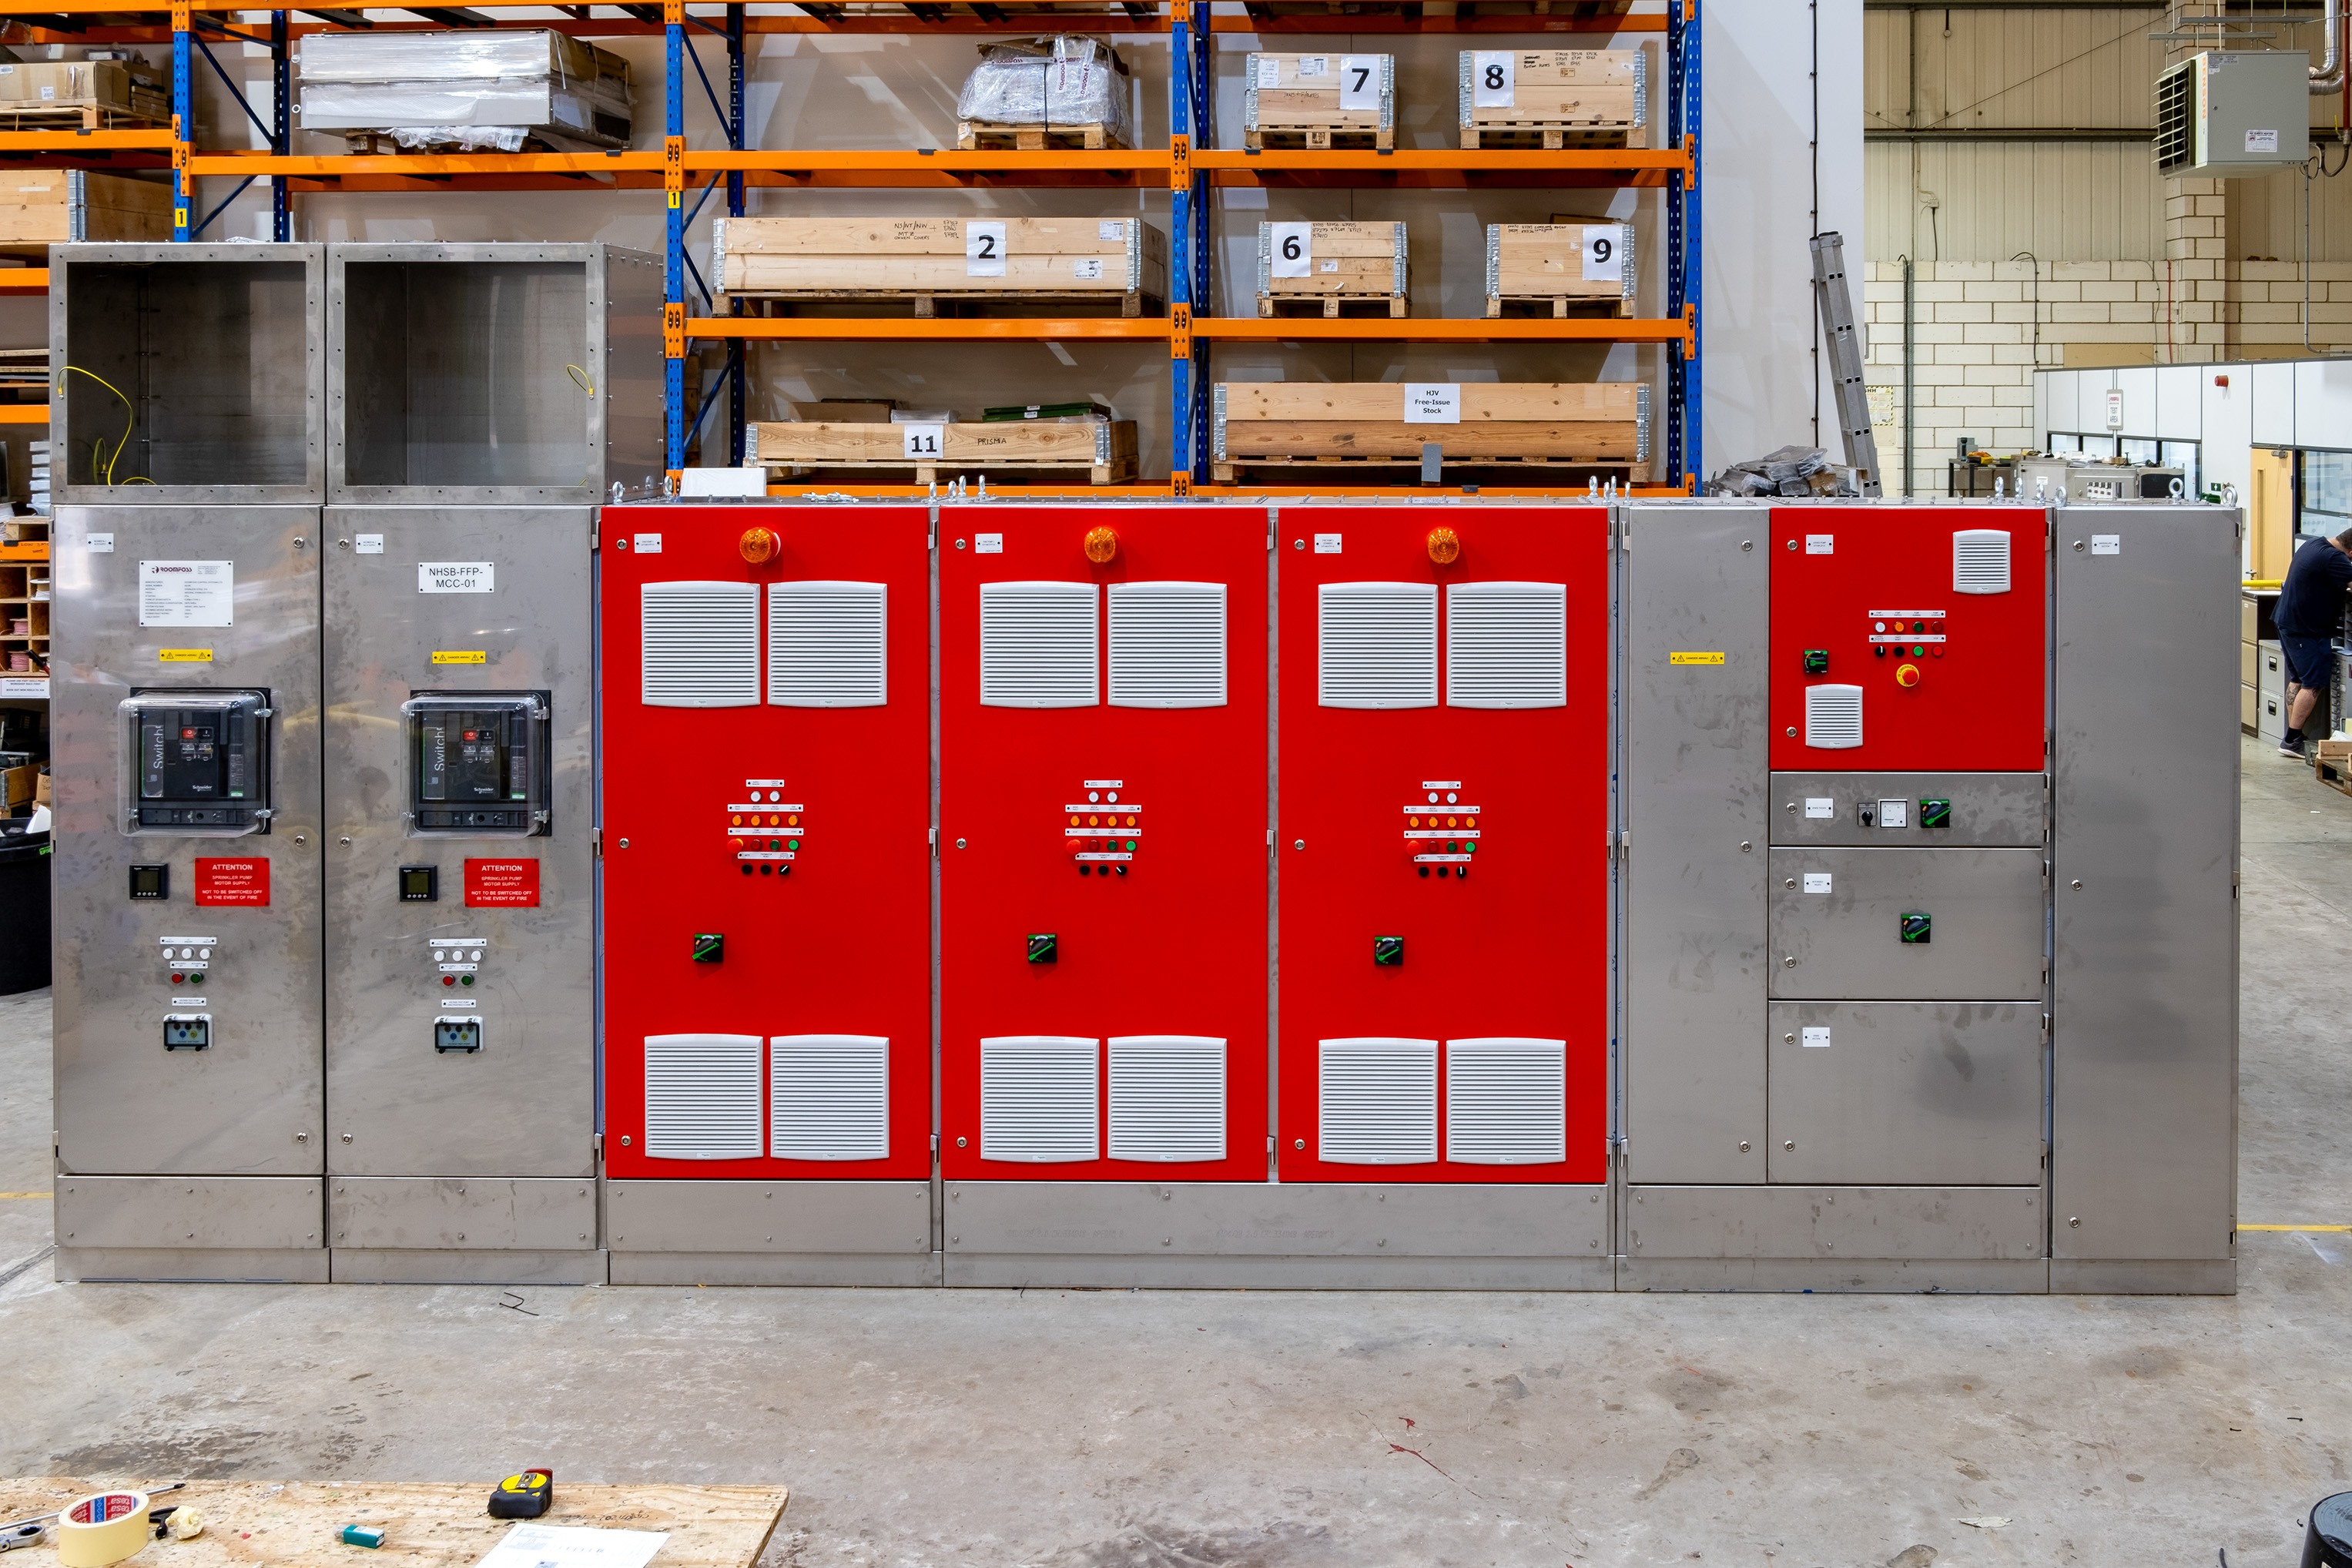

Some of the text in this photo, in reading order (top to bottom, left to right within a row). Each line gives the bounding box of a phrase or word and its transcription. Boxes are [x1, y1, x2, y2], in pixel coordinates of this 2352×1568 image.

[1352, 68, 1370, 92] 7
[1485, 64, 1504, 90] 8
[672, 193, 677, 205] 1
[179, 211, 184, 224] 1
[978, 235, 996, 259] 2
[1282, 235, 1301, 260] 6
[1592, 238, 1612, 263] 9
[911, 435, 937, 452] 11
[429, 568, 483, 576] NHSB-FFP-
